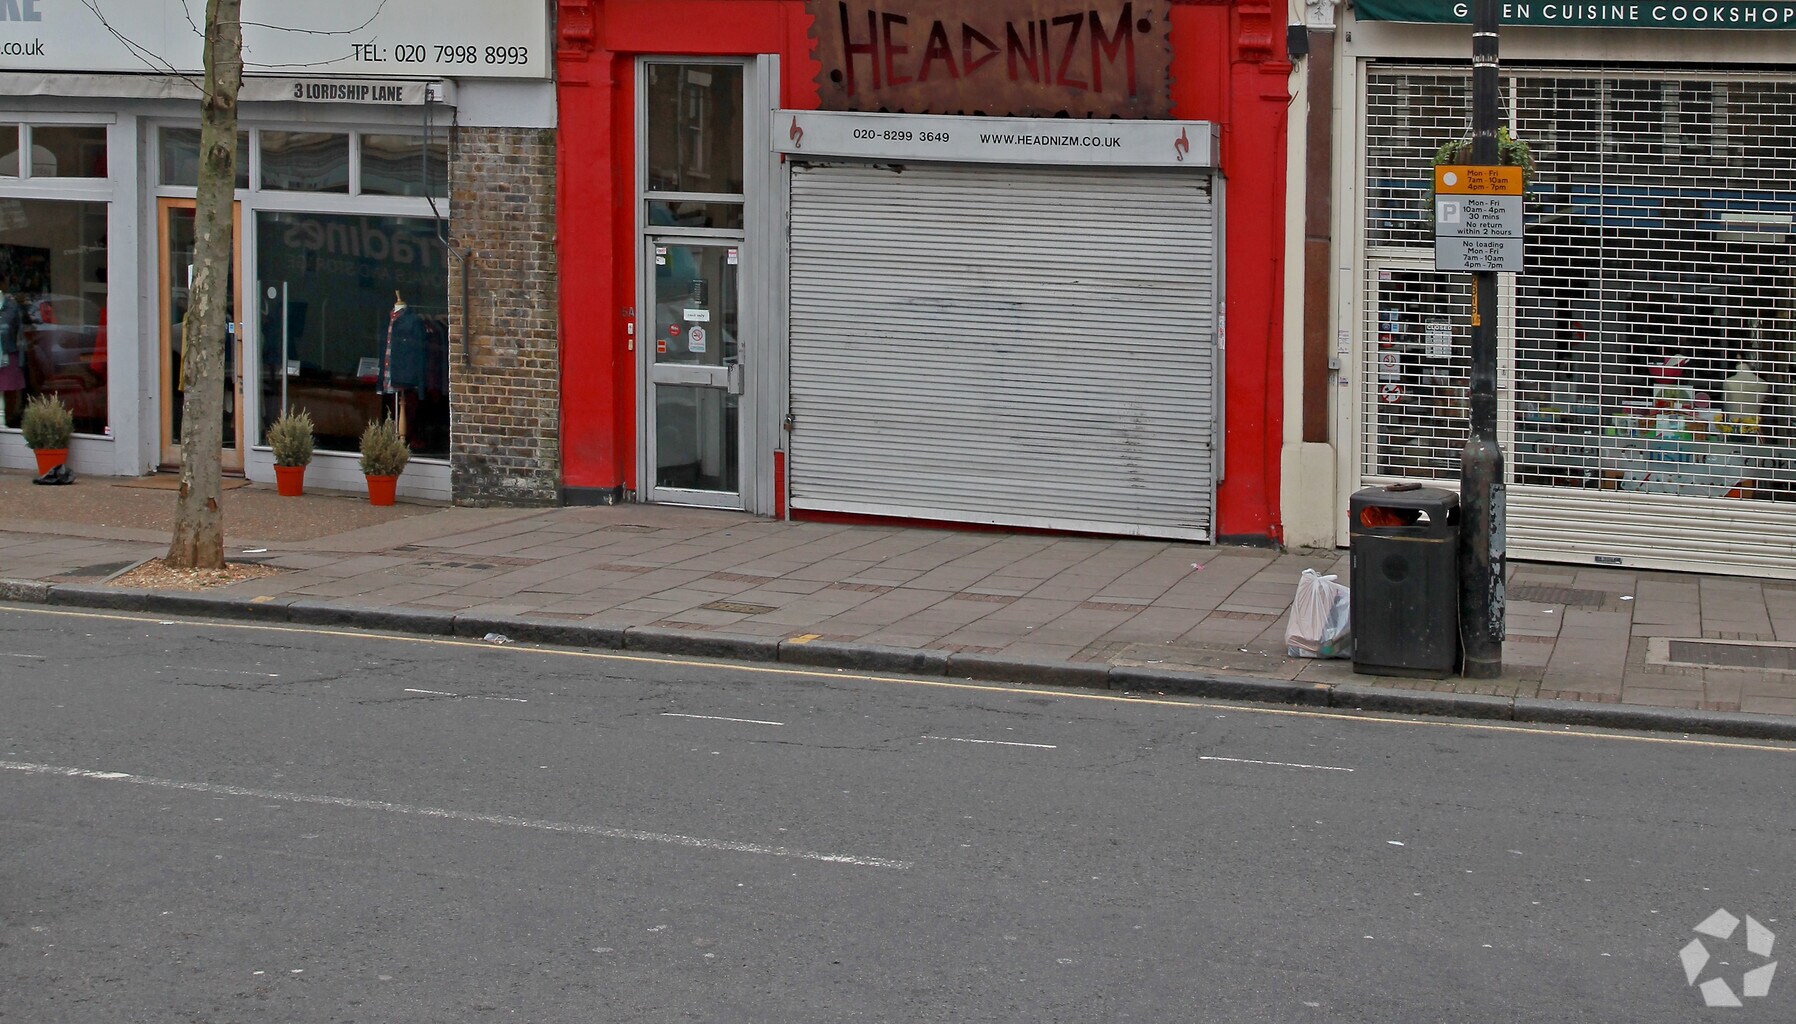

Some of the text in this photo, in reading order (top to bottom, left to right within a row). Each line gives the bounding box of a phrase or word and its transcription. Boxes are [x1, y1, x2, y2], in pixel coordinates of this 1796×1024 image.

[1453, 2, 1795, 23] GEN CUISINE COOKSHOP
[351, 43, 528, 65] TEL: 020 7998 8993
[838, 0, 1138, 98] HEADNIZM
[294, 83, 403, 102] 3 LORDSHIP LANE
[853, 128, 950, 143] 020-8299 3649
[980, 132, 1121, 148] WWW.HEADNIZM.CO.UK
[1443, 203, 1457, 221] P
[1476, 241, 1504, 249] loading
